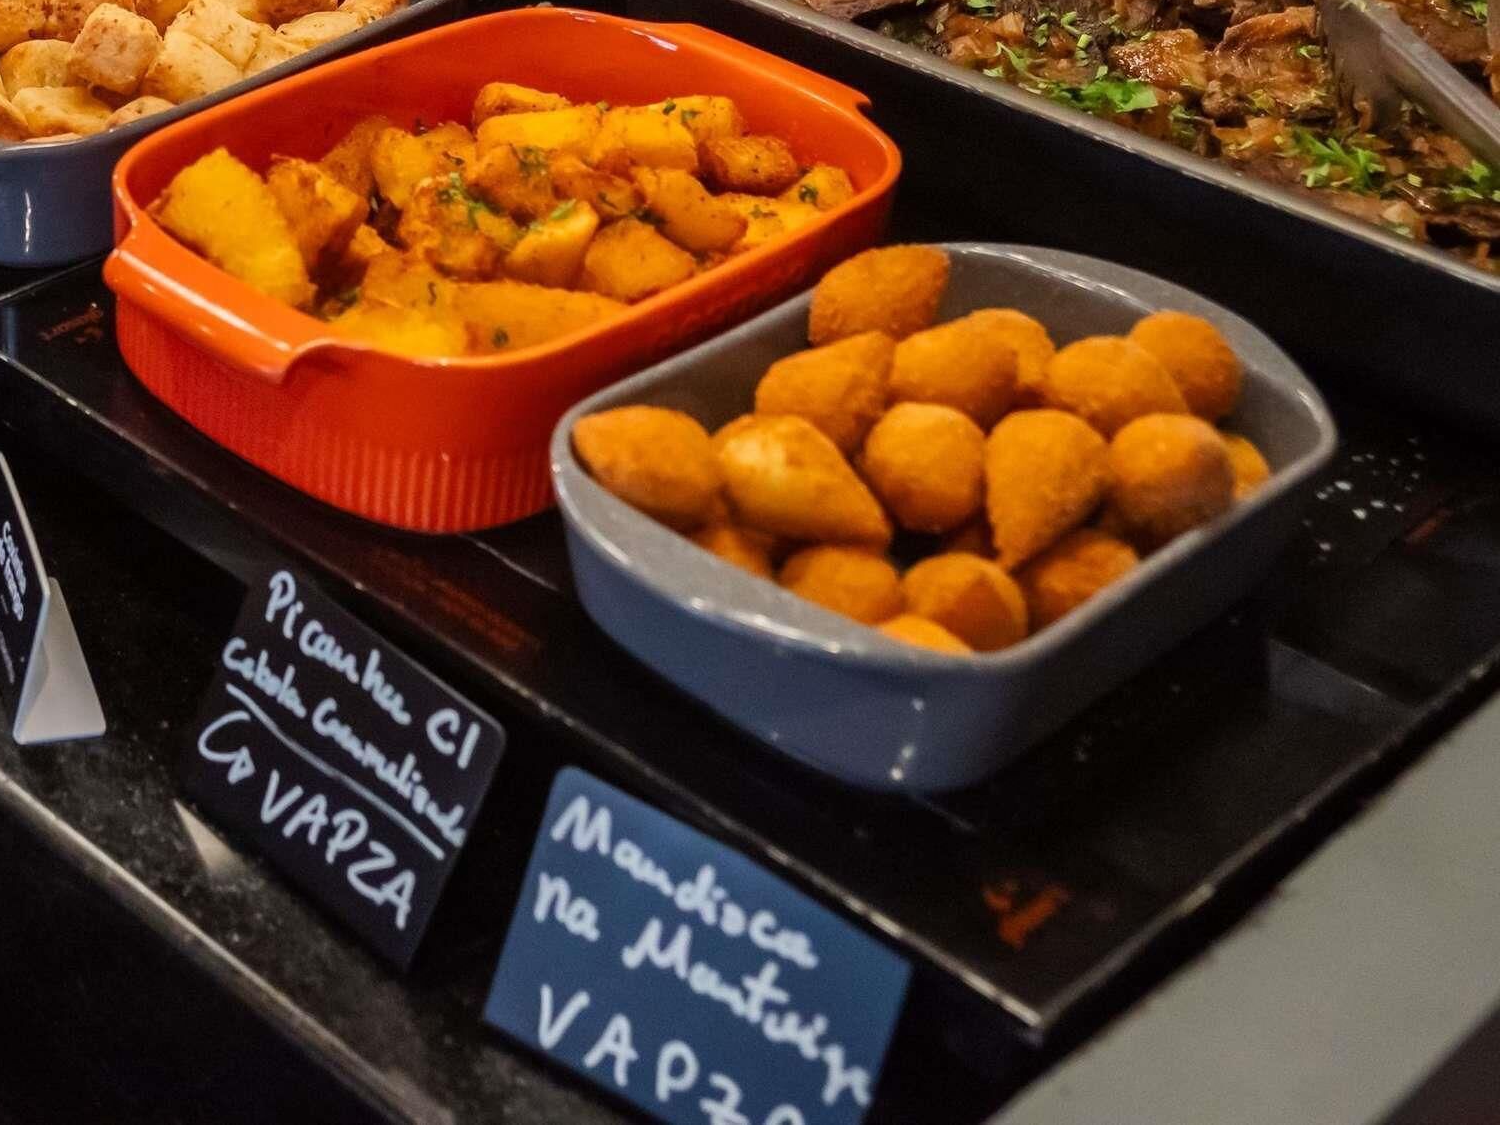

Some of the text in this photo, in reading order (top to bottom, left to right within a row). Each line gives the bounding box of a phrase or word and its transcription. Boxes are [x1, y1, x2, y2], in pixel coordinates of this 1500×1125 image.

[264, 570, 412, 726] Picanha
[260, 768, 417, 931] VAPZA
[532, 870, 600, 943] na
[549, 794, 819, 970] Mandioca
